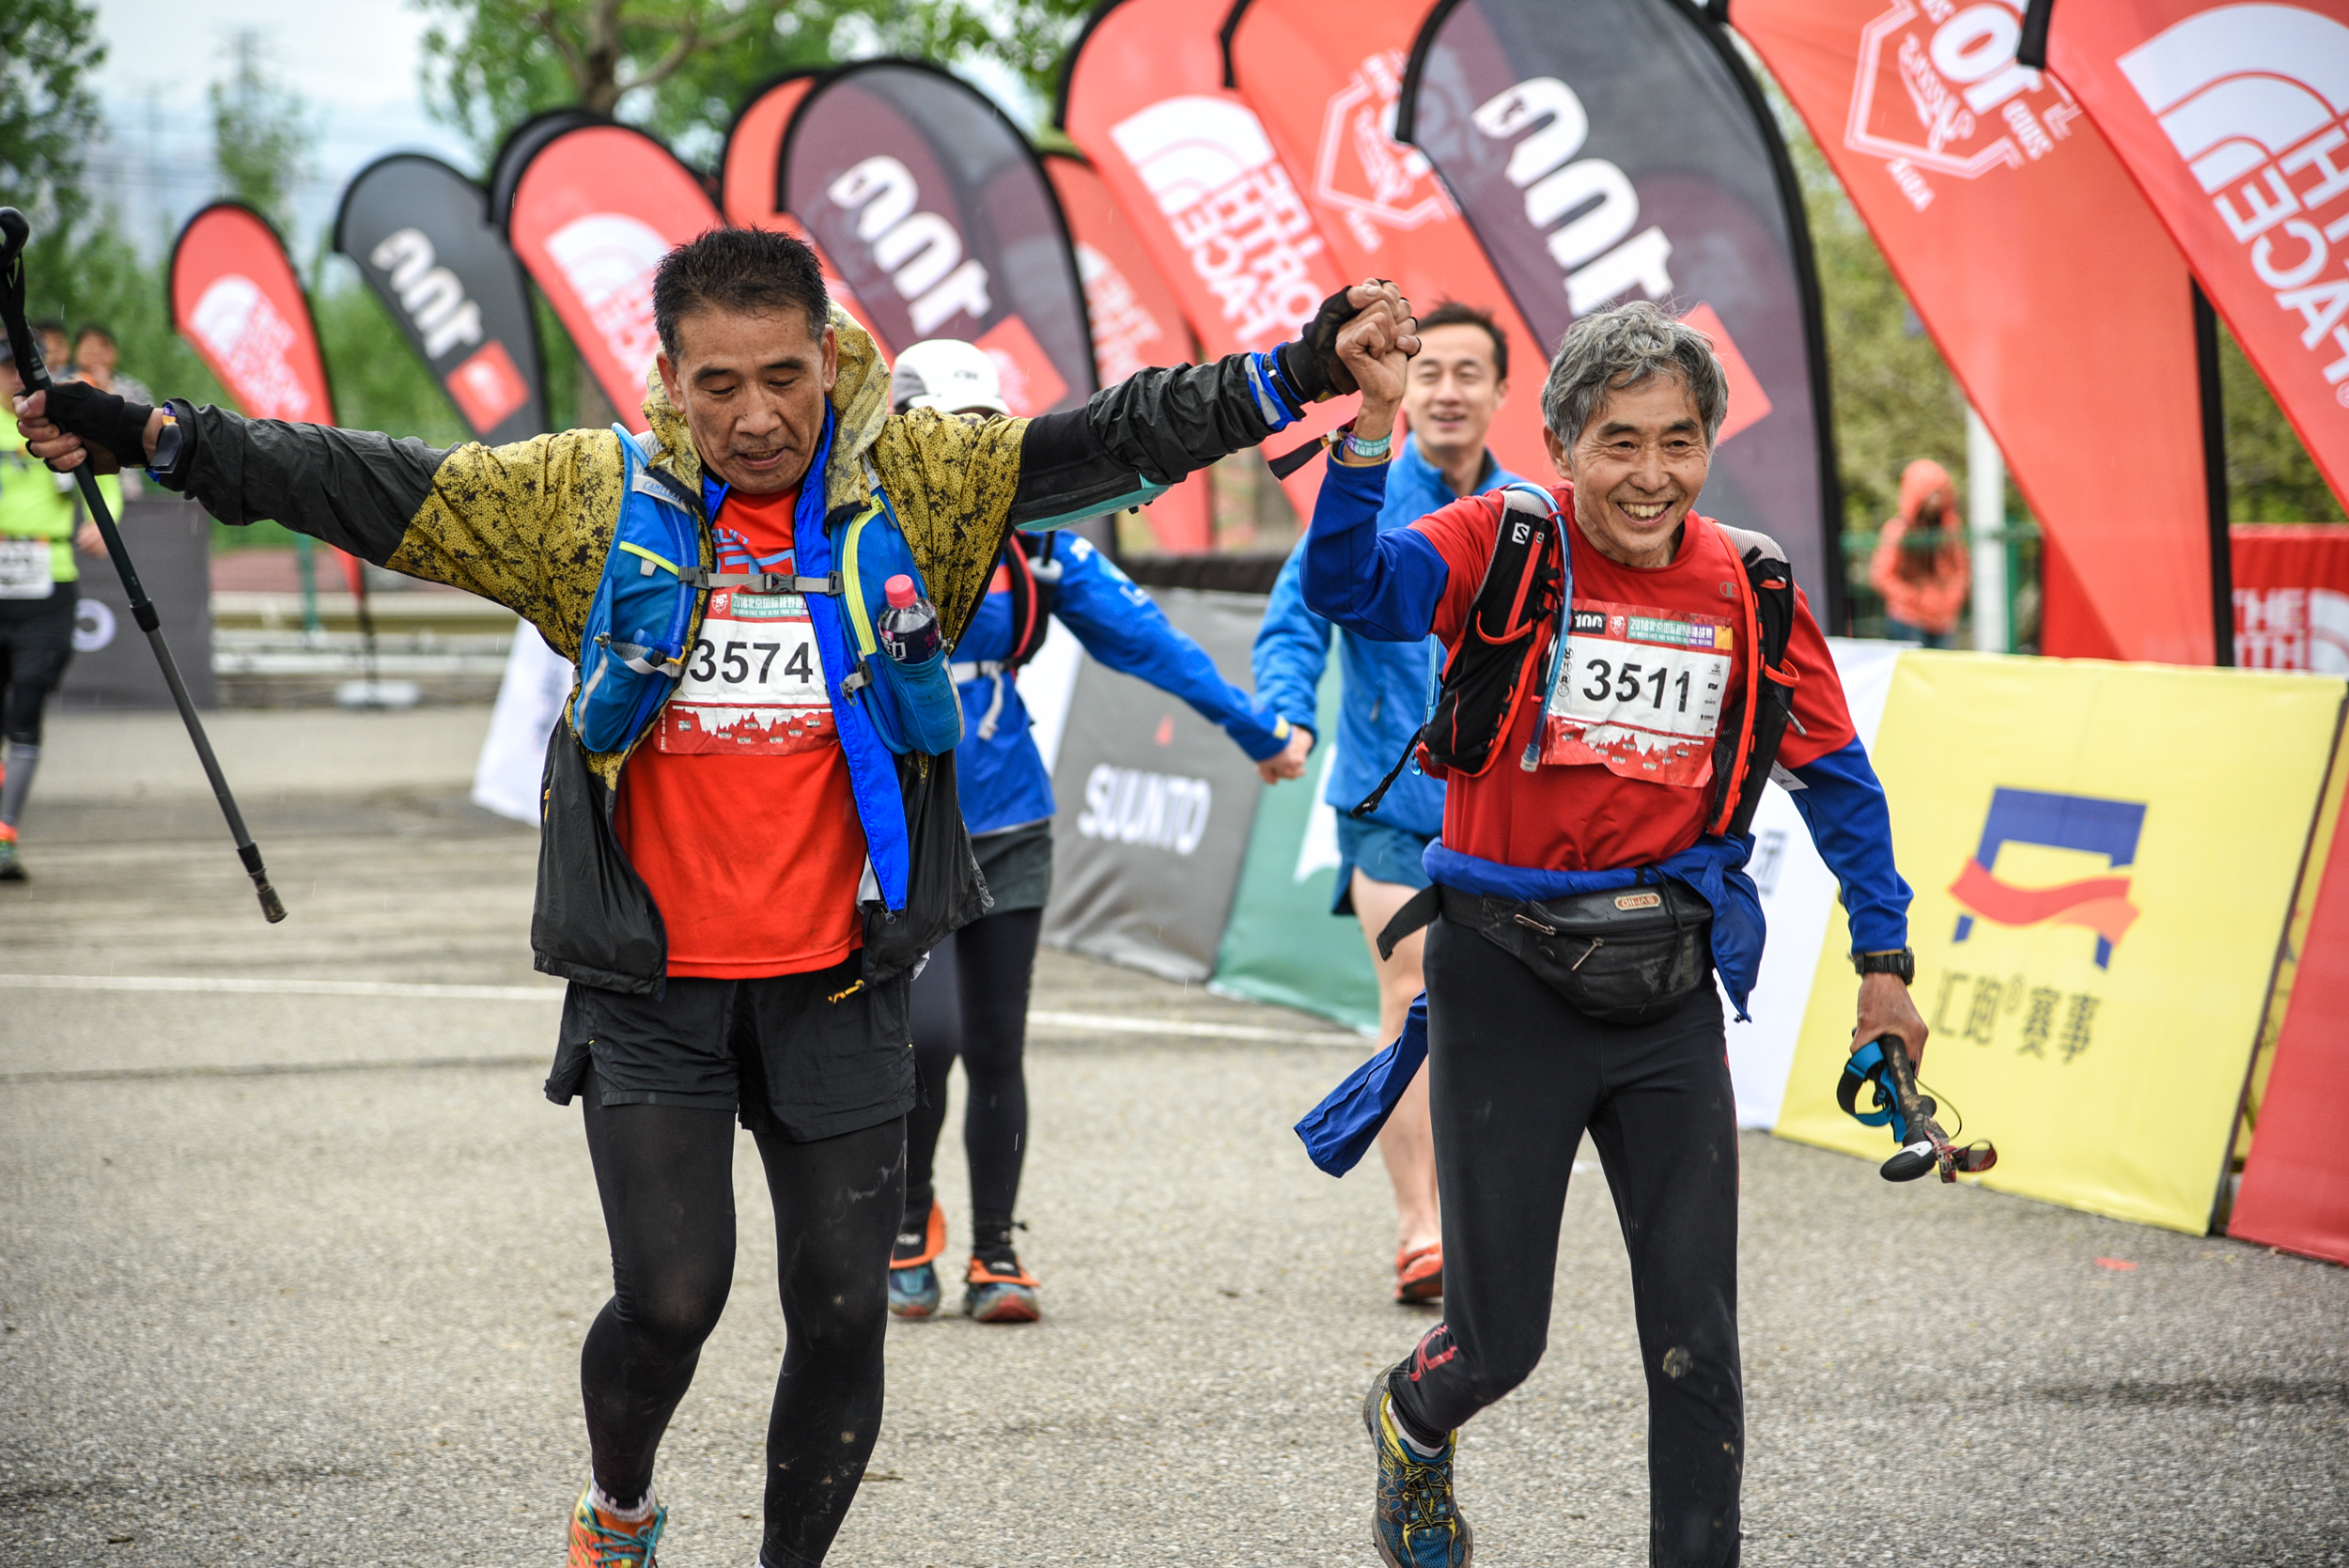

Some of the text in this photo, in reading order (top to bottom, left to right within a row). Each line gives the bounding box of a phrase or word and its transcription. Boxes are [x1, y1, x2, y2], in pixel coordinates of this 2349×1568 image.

[1575, 614, 1602, 629] 100
[690, 640, 814, 685] 3574
[1583, 659, 1690, 713] 3511
[1078, 762, 1211, 856] SUUNTO
